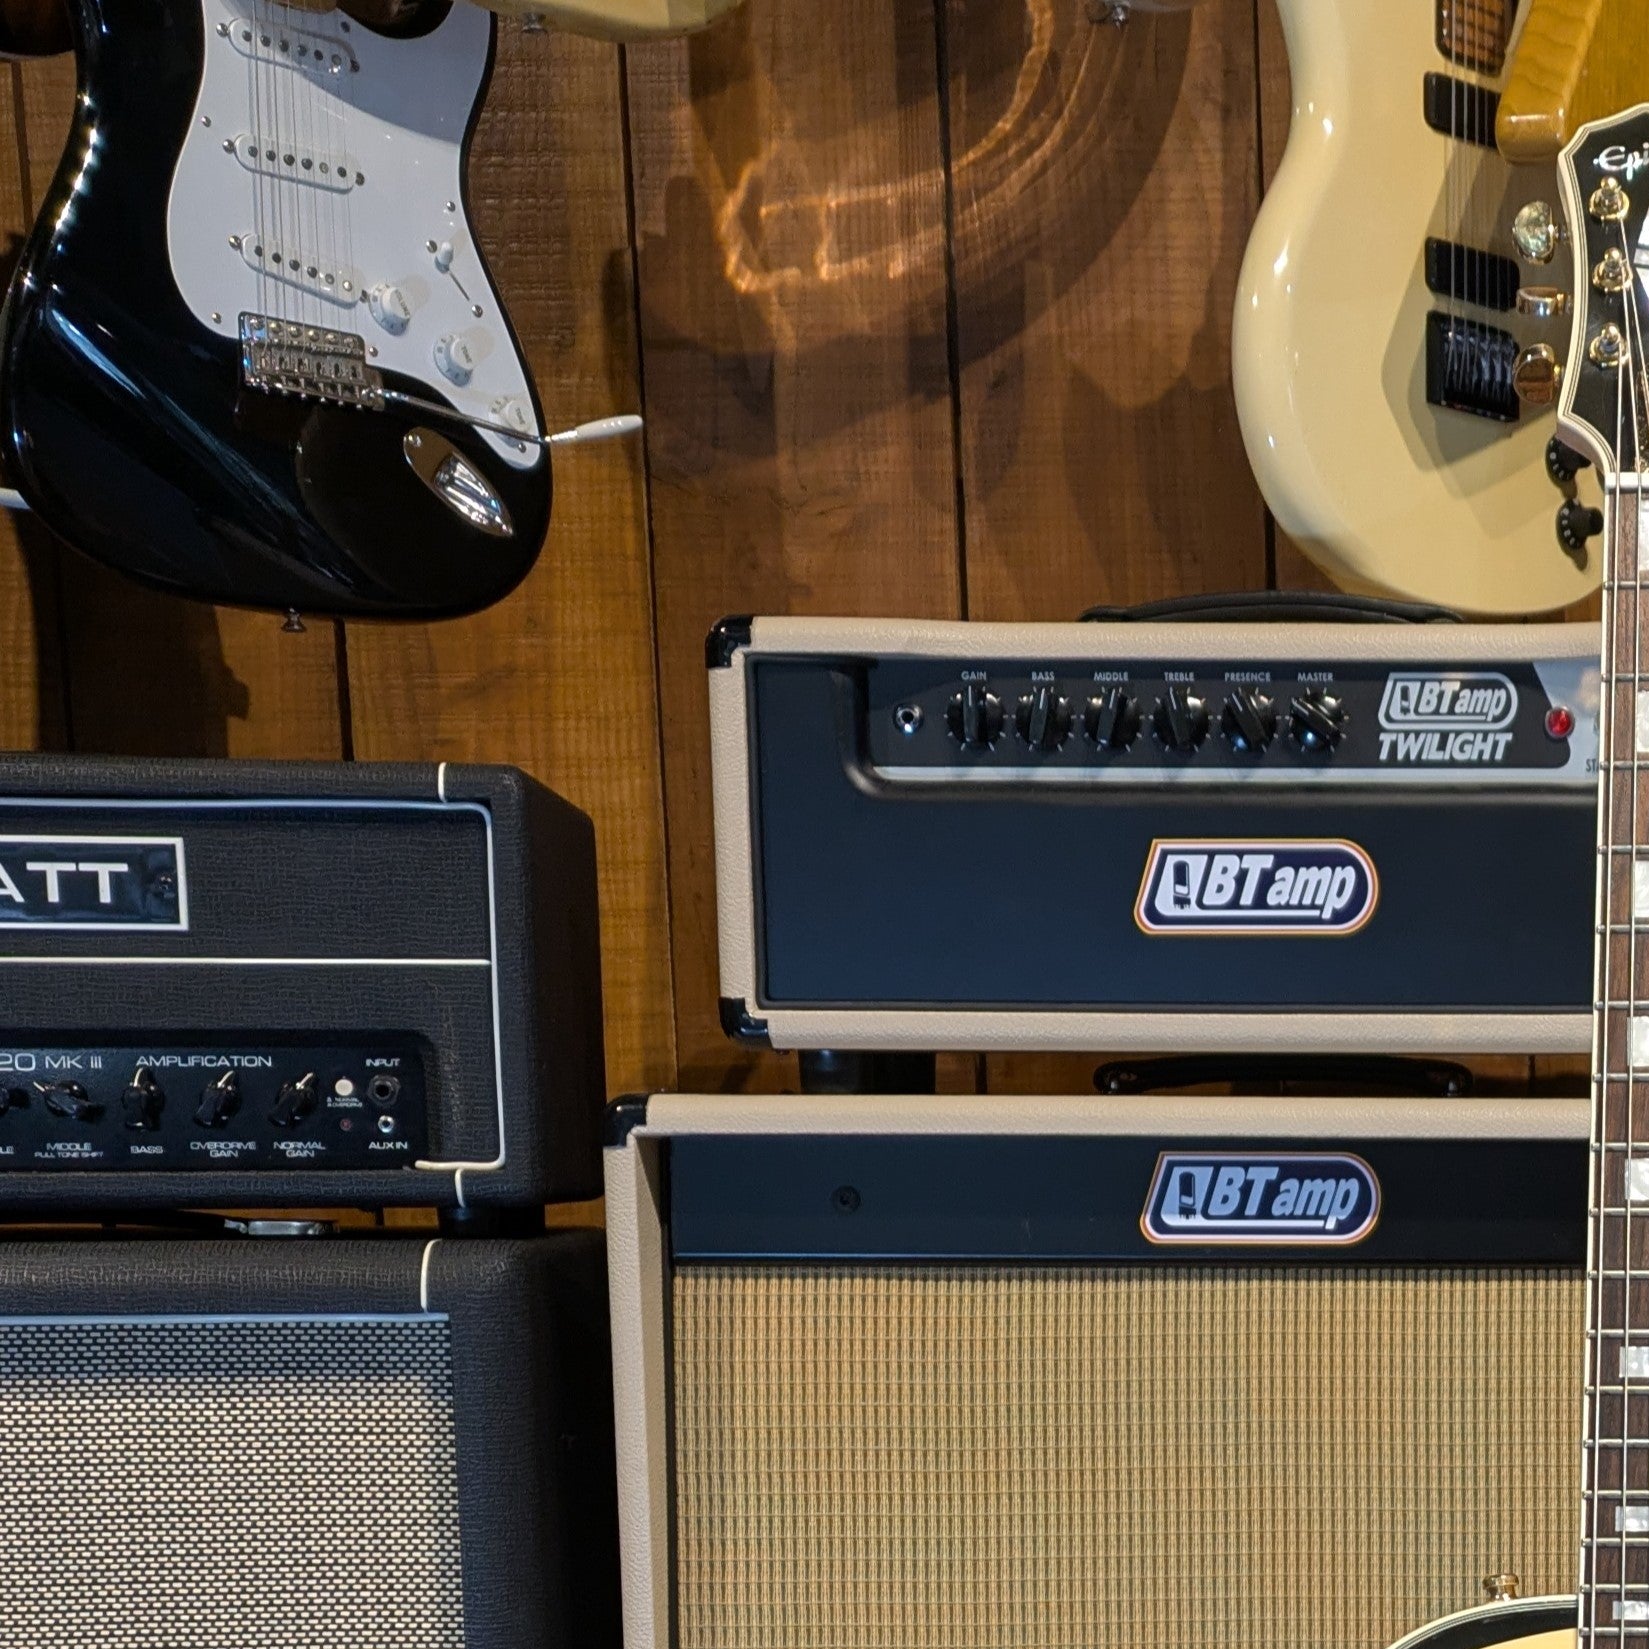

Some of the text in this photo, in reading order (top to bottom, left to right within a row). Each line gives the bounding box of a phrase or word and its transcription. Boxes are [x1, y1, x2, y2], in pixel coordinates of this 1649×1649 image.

[961, 671, 987, 681] GAIN
[1031, 671, 1055, 682] BASS
[1094, 671, 1129, 682] MIDDLE
[1164, 671, 1195, 682] TREBLE
[1224, 671, 1271, 682] PRESENCE
[1297, 671, 1334, 682] MASTER
[1418, 680, 1507, 722] BT amp
[1379, 732, 1513, 761] TWILIGHT
[1585, 758, 1600, 773] ST
[1202, 854, 1356, 919] BT amp
[45, 1055, 82, 1069] MK
[136, 1055, 272, 1068] AMPLIFICATION
[365, 1058, 401, 1067] INPUT
[46, 1142, 92, 1152] MIDDLE
[130, 1145, 164, 1155] BASS
[190, 1141, 256, 1150] OVERDRIVE
[273, 1141, 326, 1150] NORMAL
[369, 1141, 396, 1150] AUX
[209, 1150, 239, 1158] GAIN
[286, 1150, 315, 1158] GAIN
[1207, 1166, 1360, 1230] BT amp
